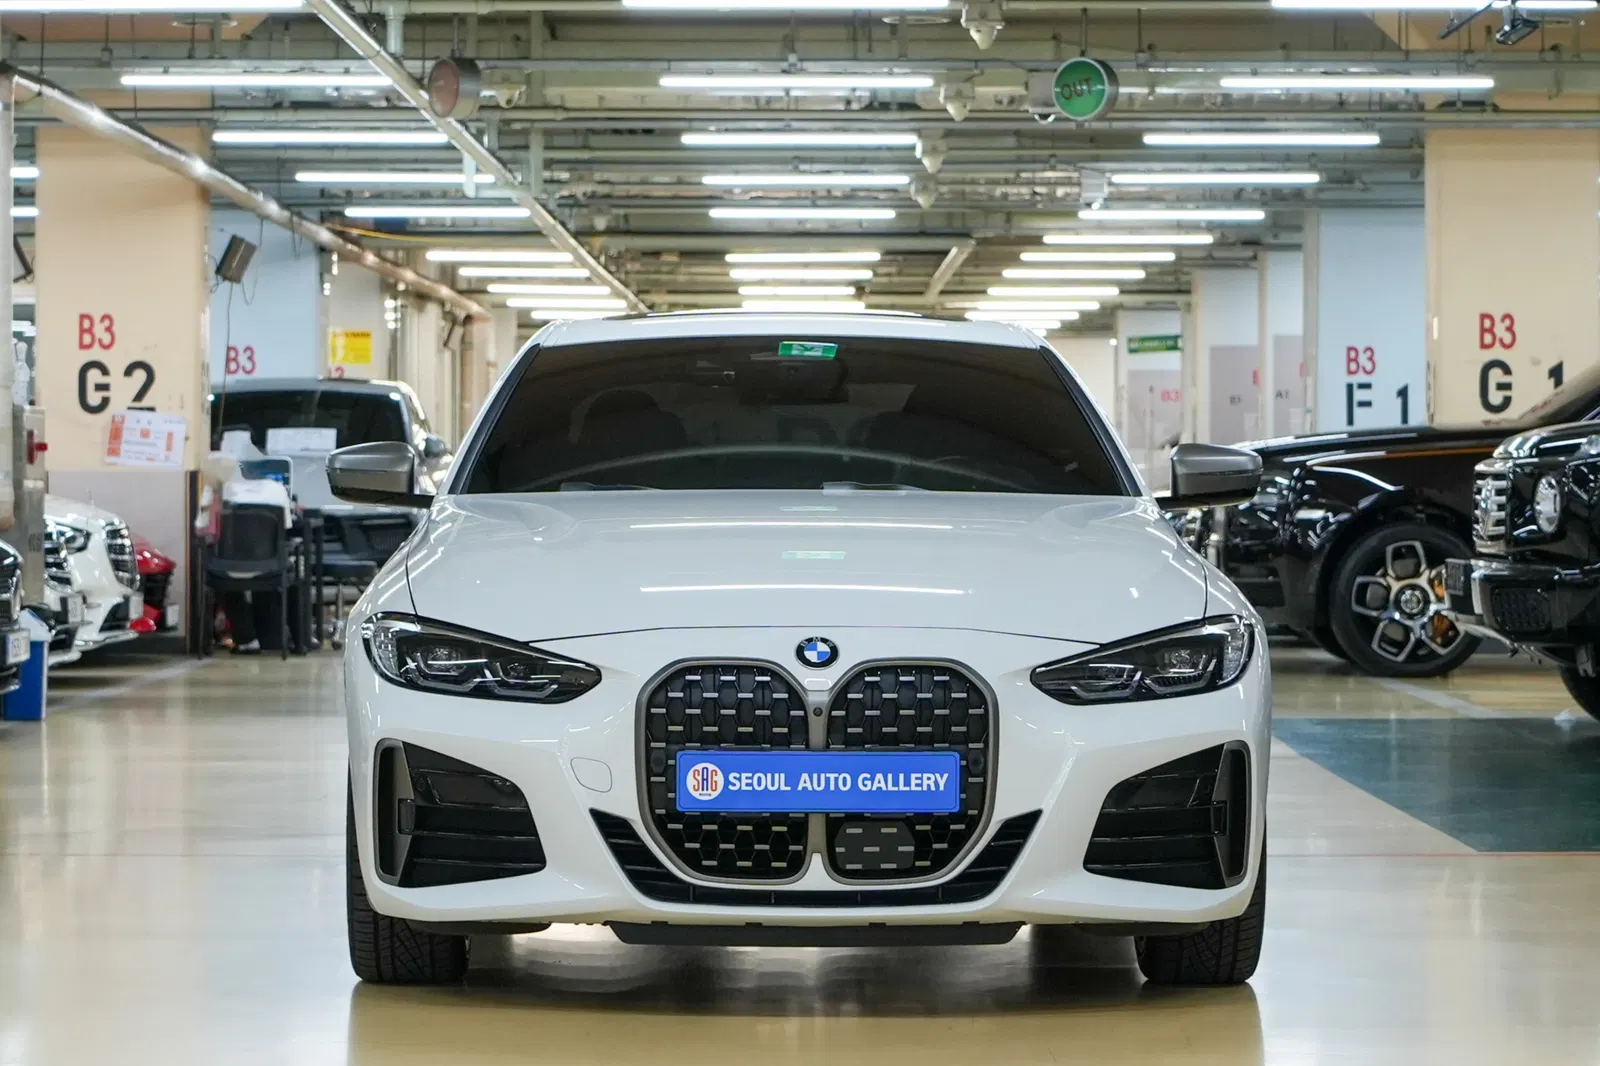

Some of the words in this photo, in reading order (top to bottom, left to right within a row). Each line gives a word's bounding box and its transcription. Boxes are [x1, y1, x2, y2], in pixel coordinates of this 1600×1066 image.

[1061, 77, 1092, 100] OUT
[79, 313, 116, 350] B3
[1479, 313, 1517, 350] B3
[226, 346, 256, 375] B3
[1346, 346, 1376, 375] B3
[1479, 359, 1513, 414] G
[1346, 382, 1372, 426] F
[1396, 383, 1409, 425] 1
[800, 636, 835, 648] BMW
[692, 766, 718, 792] SAG
[728, 772, 791, 791] SEOUL
[797, 772, 851, 791] AUTO
[858, 772, 949, 791] GALLERY
